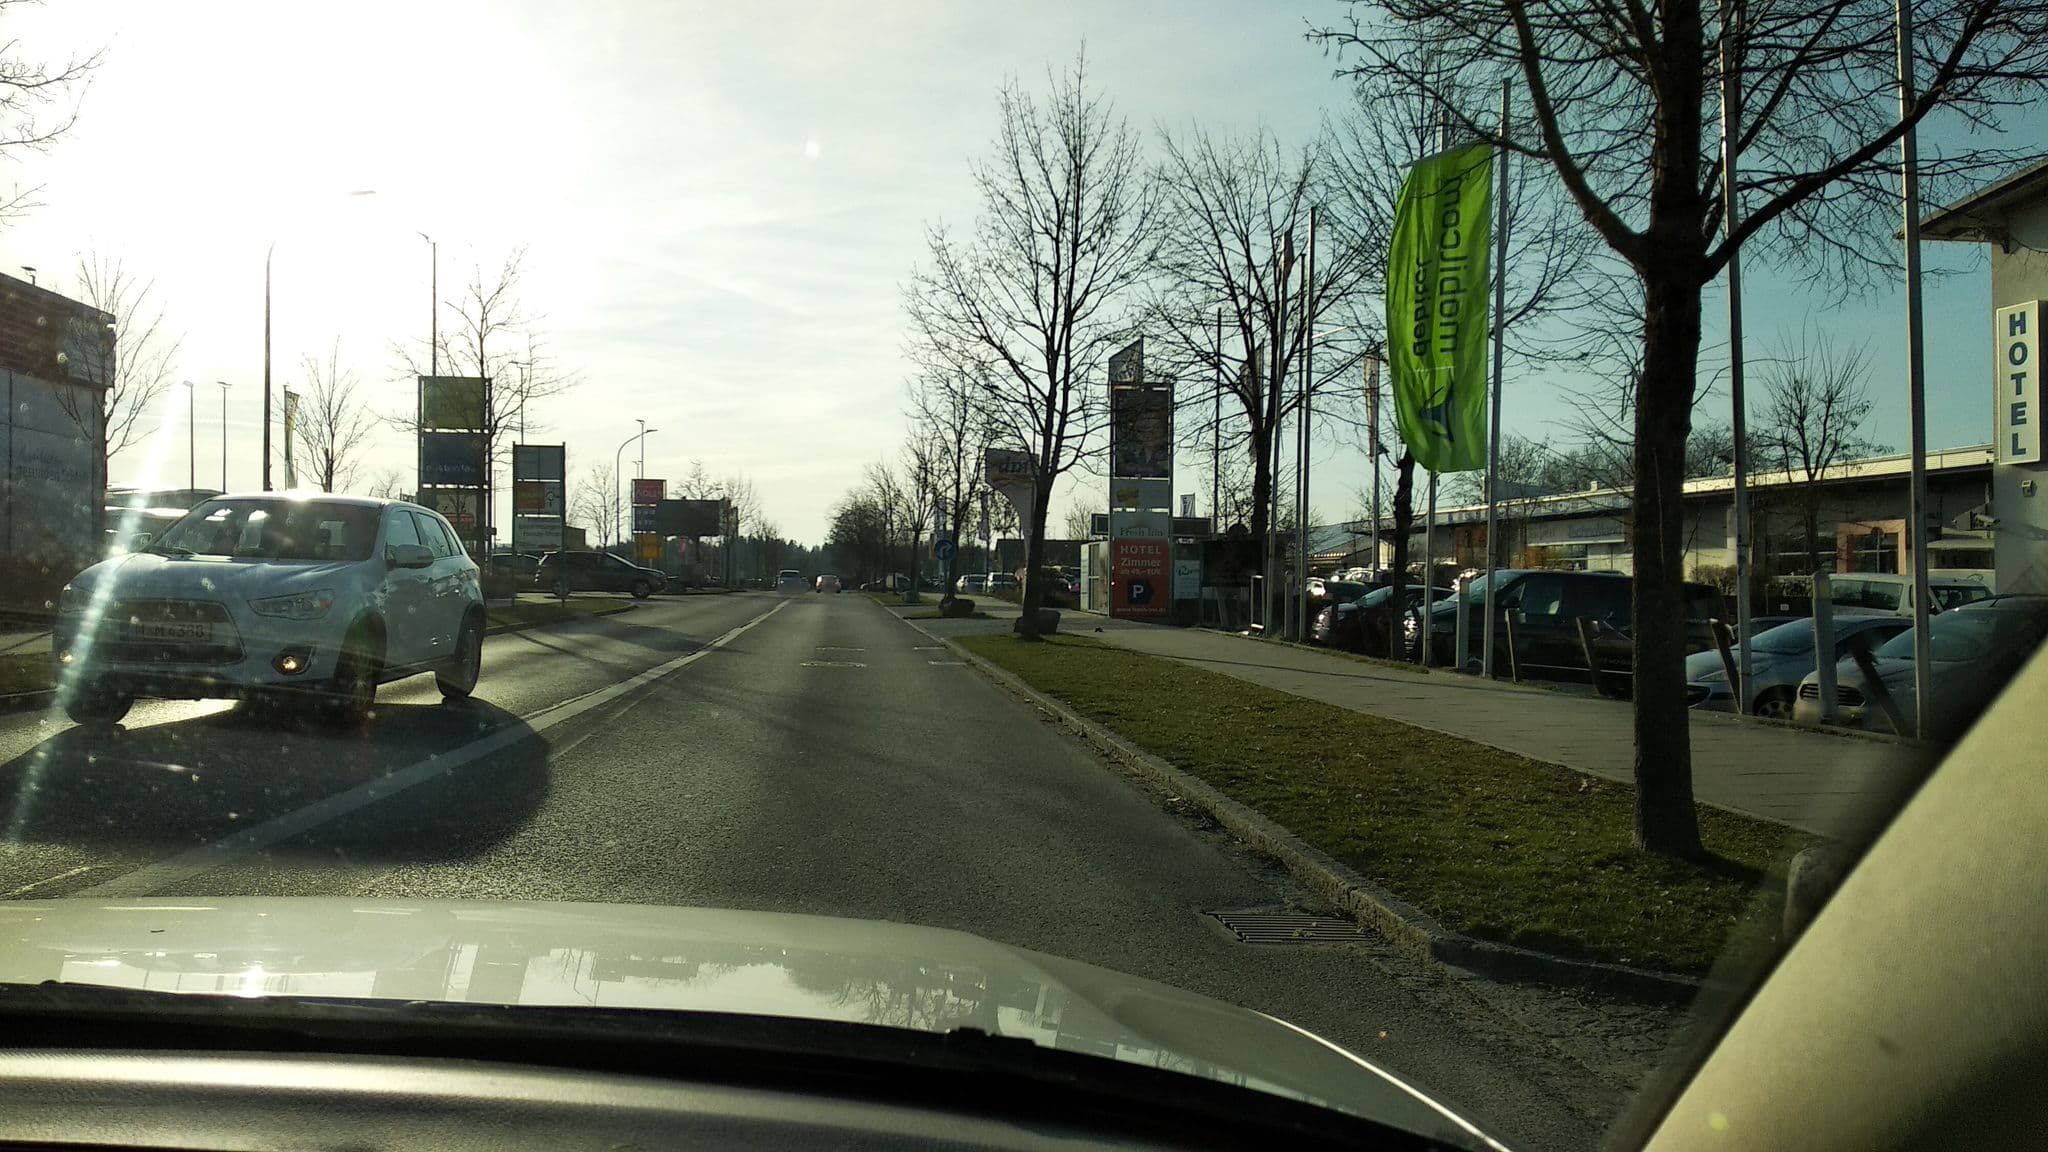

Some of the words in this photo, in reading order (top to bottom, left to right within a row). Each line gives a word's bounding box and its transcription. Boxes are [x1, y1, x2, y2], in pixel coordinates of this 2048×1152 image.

[2008, 310, 2029, 456] HOTEL
[1120, 545, 1161, 555] HOTEL
[1120, 558, 1161, 568] Zimmer
[1133, 585, 1144, 598] P
